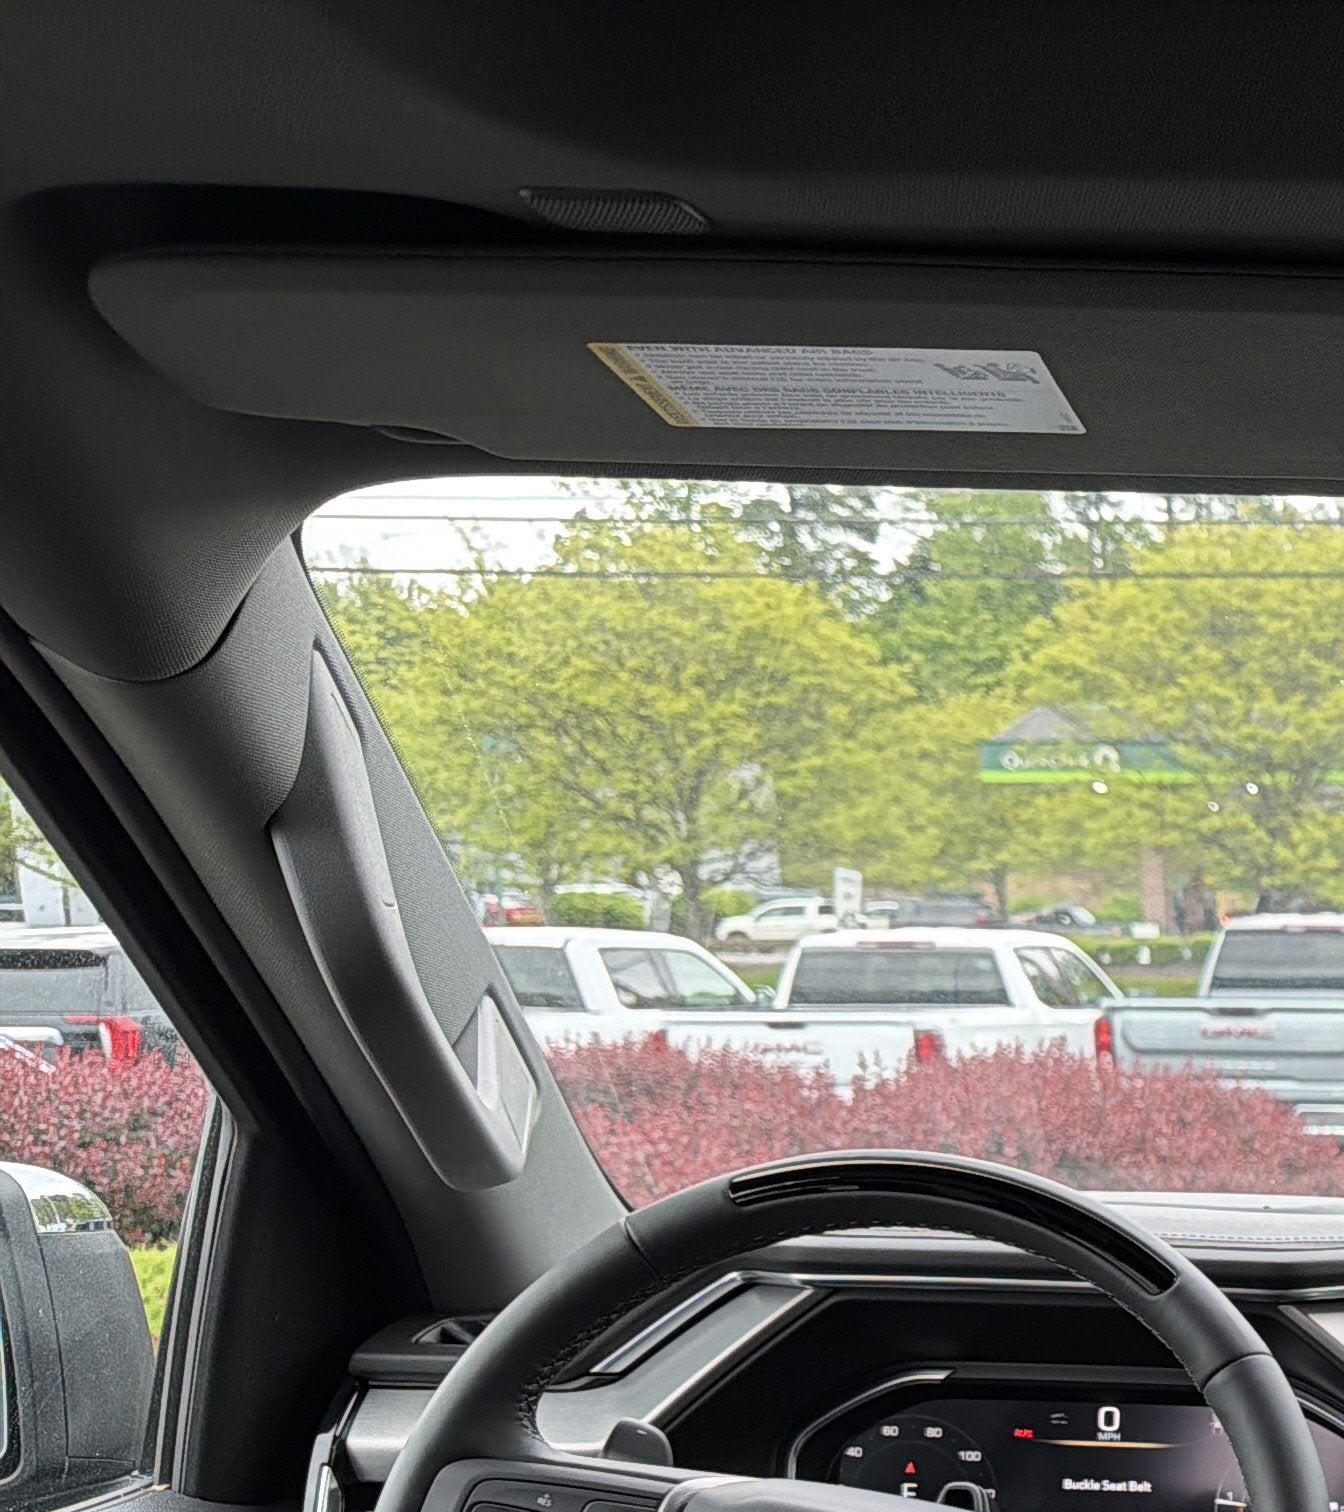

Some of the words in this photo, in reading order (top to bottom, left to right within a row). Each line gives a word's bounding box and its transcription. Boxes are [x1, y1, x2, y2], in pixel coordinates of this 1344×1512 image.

[1097, 1406, 1121, 1432] 0
[1097, 1432, 1121, 1442] MPH
[958, 1451, 982, 1462] 100
[1062, 1478, 1100, 1491] Buckle
[1102, 1479, 1126, 1492] Seat
[1128, 1480, 1152, 1492] Belt
